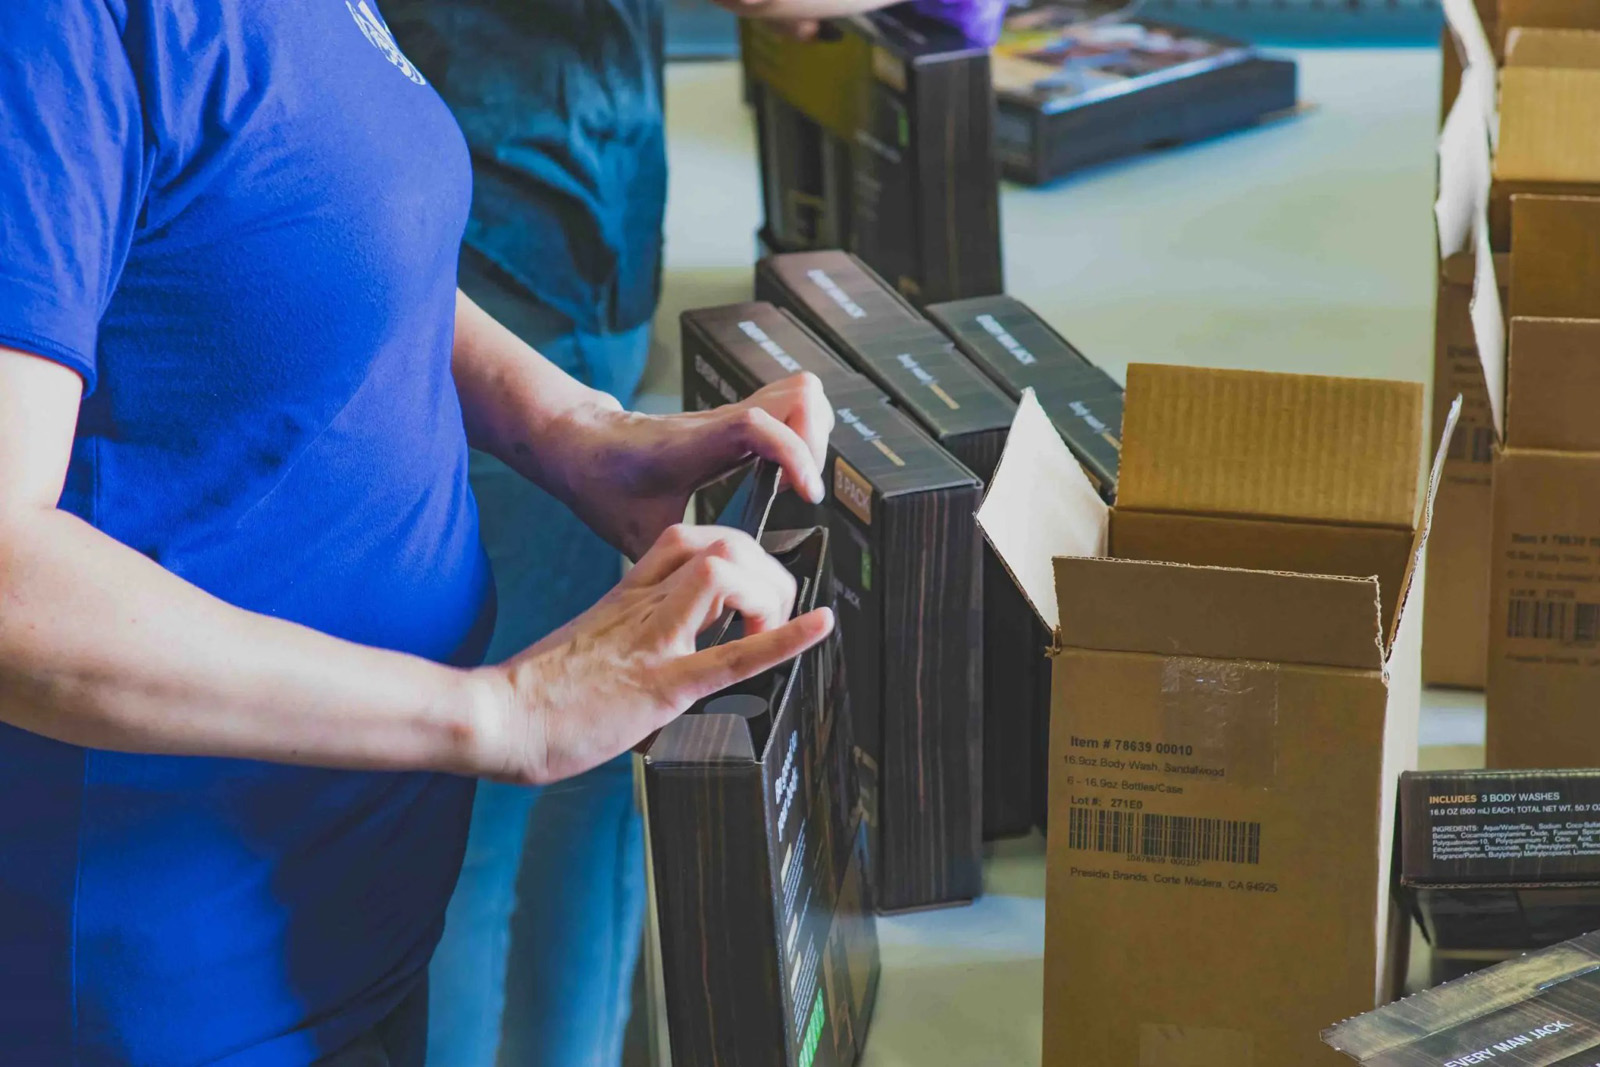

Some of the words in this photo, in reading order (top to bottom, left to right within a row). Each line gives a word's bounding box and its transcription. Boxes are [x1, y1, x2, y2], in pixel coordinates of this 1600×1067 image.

[1070, 735, 1099, 749] Item
[1103, 738, 1111, 750] #
[1114, 740, 1152, 752] 78639
[1156, 742, 1193, 756] 00010
[1063, 754, 1097, 767] 16.9oz
[1100, 758, 1126, 771] Body
[1163, 762, 1226, 777] Sandalwood
[1067, 775, 1075, 785] 6
[1085, 777, 1118, 789] 16.9oz
[1121, 780, 1184, 795] Bottles/Case
[1070, 795, 1089, 806] Lot
[1092, 797, 1102, 807] #:
[1429, 794, 1478, 804] INCLUDES
[1481, 794, 1489, 803] 3
[1489, 793, 1517, 803] BODY
[1518, 791, 1561, 801] WASHES
[1446, 808, 1459, 816] OZ
[1459, 807, 1476, 815] (500
[1517, 805, 1541, 814] TOTAL
[1542, 804, 1557, 813] NET
[1070, 866, 1111, 880] Presidio
[1153, 873, 1181, 885] Corte
[1228, 880, 1245, 890] CA
[1443, 1048, 1497, 1067] EVERY
[1492, 1033, 1534, 1053] MAN
[1529, 1019, 1573, 1039] JACK
